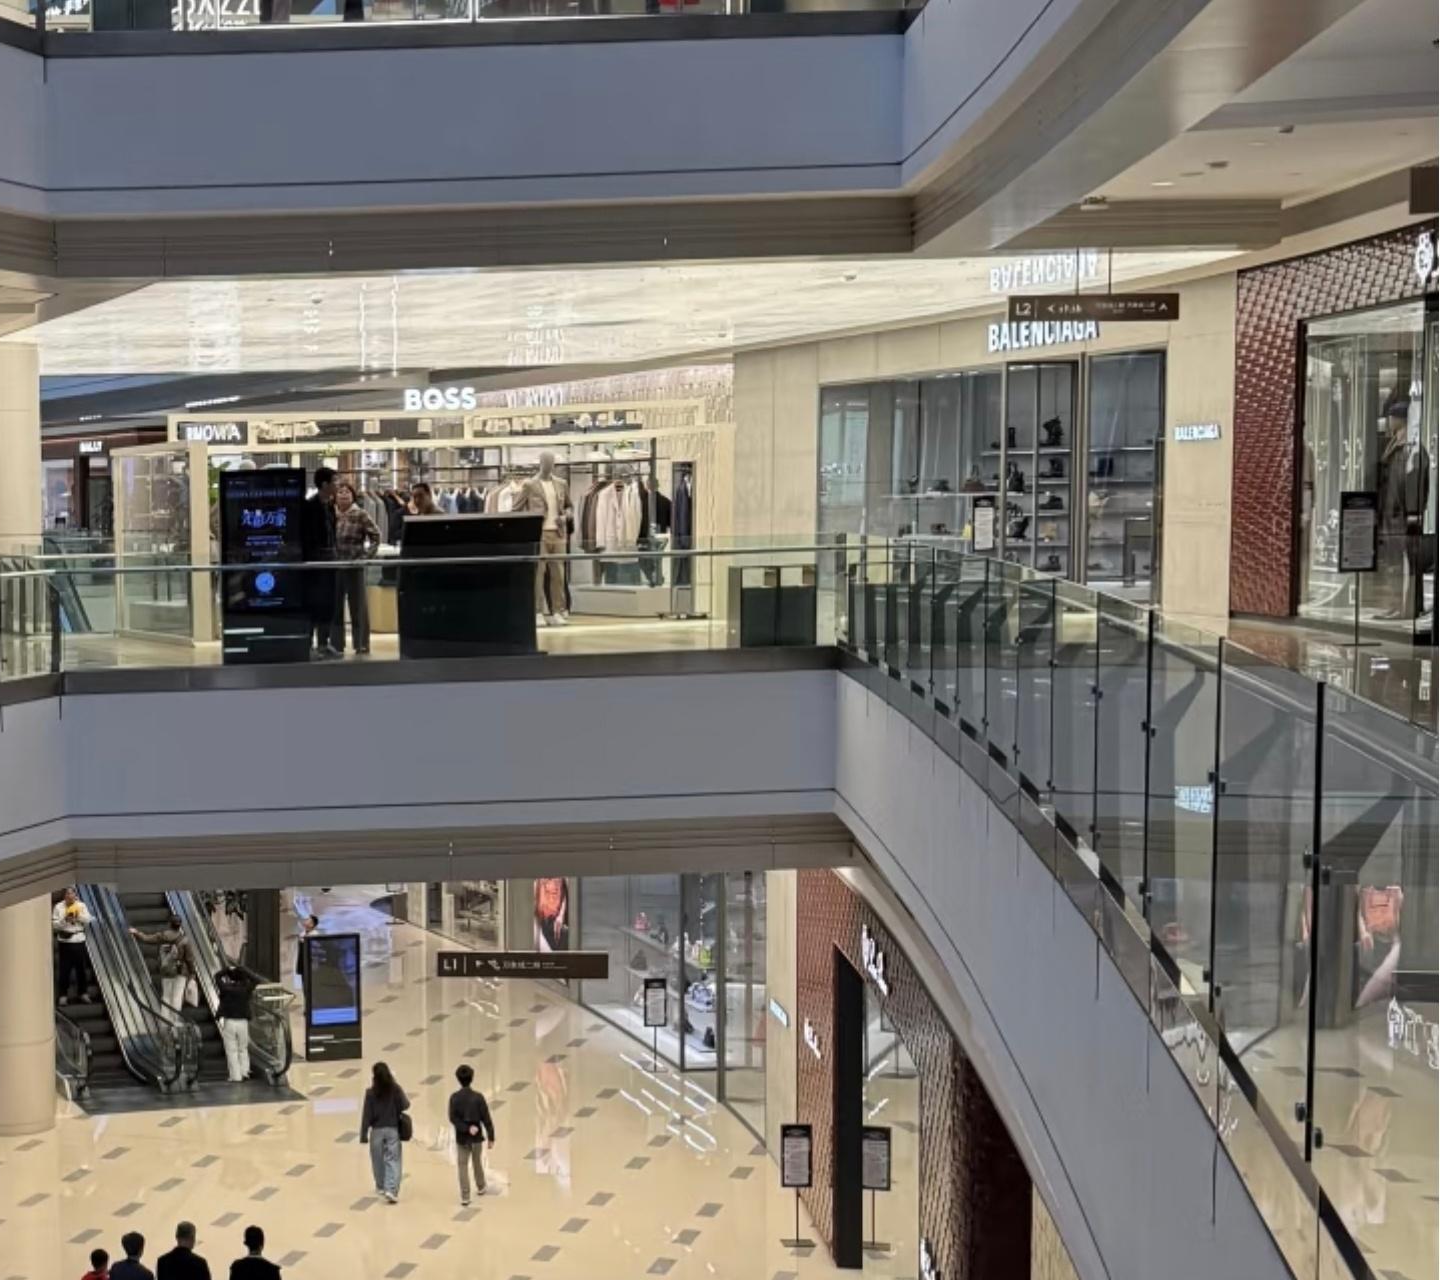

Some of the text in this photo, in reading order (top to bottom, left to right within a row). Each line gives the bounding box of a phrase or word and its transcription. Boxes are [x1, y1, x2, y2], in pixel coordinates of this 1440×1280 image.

[1015, 302, 1032, 316] L2
[988, 320, 1100, 352] BALENCIAGA
[403, 387, 476, 411] BOSS
[442, 957, 458, 971] L1
